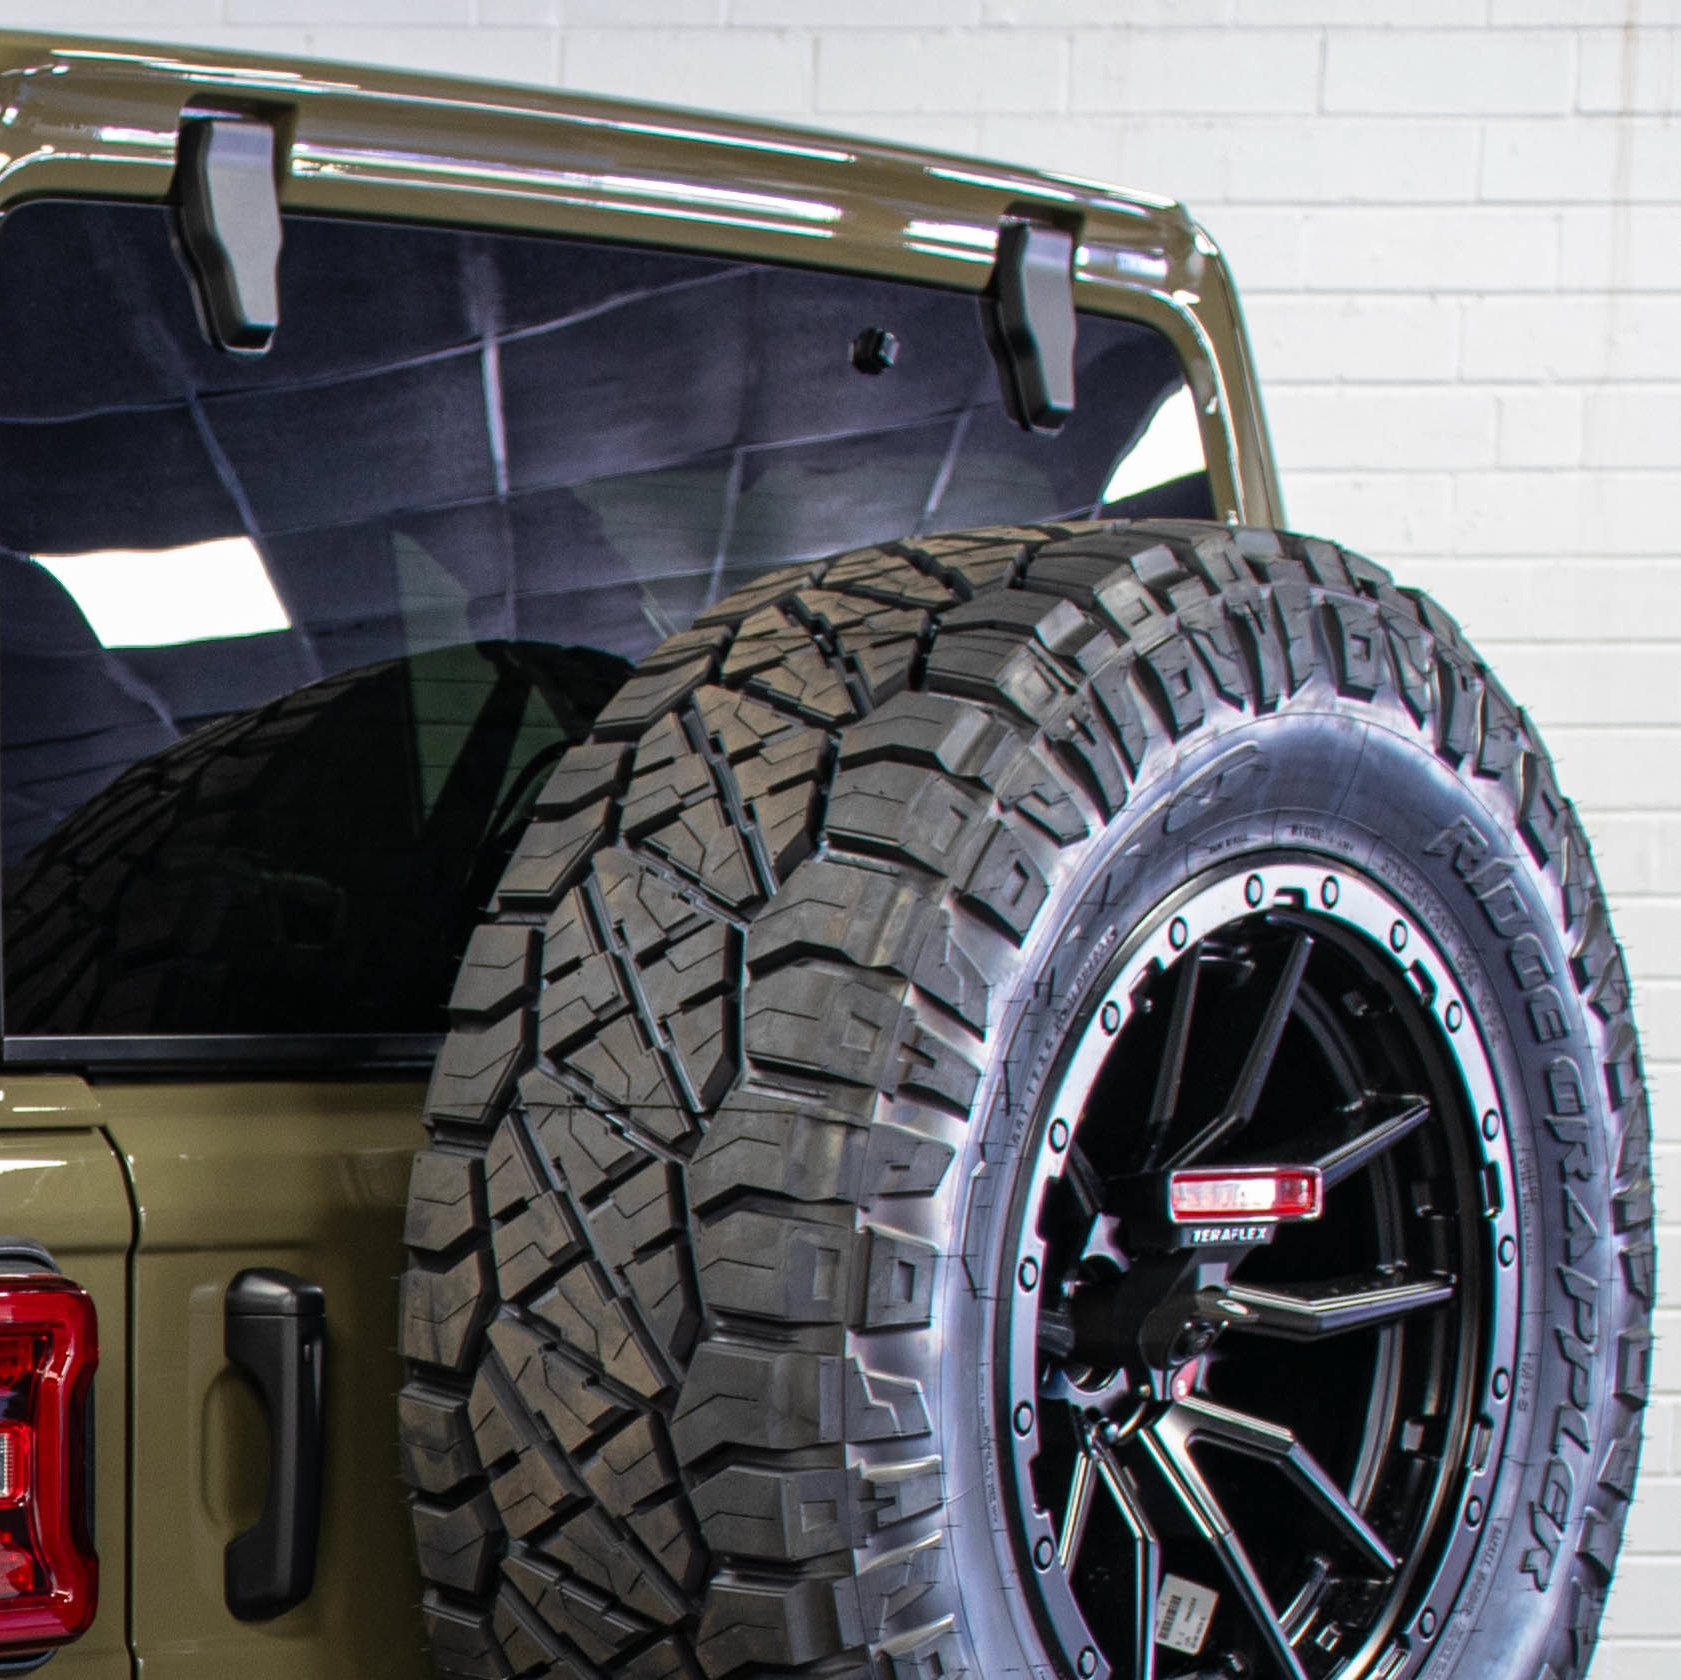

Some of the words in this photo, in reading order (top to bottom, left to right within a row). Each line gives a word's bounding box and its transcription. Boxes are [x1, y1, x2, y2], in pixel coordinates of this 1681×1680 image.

[1192, 1227, 1268, 1243] TERAFLEX
[1423, 815, 1569, 1044] RIDGE
[1520, 1056, 1599, 1592] GRAPPLER
